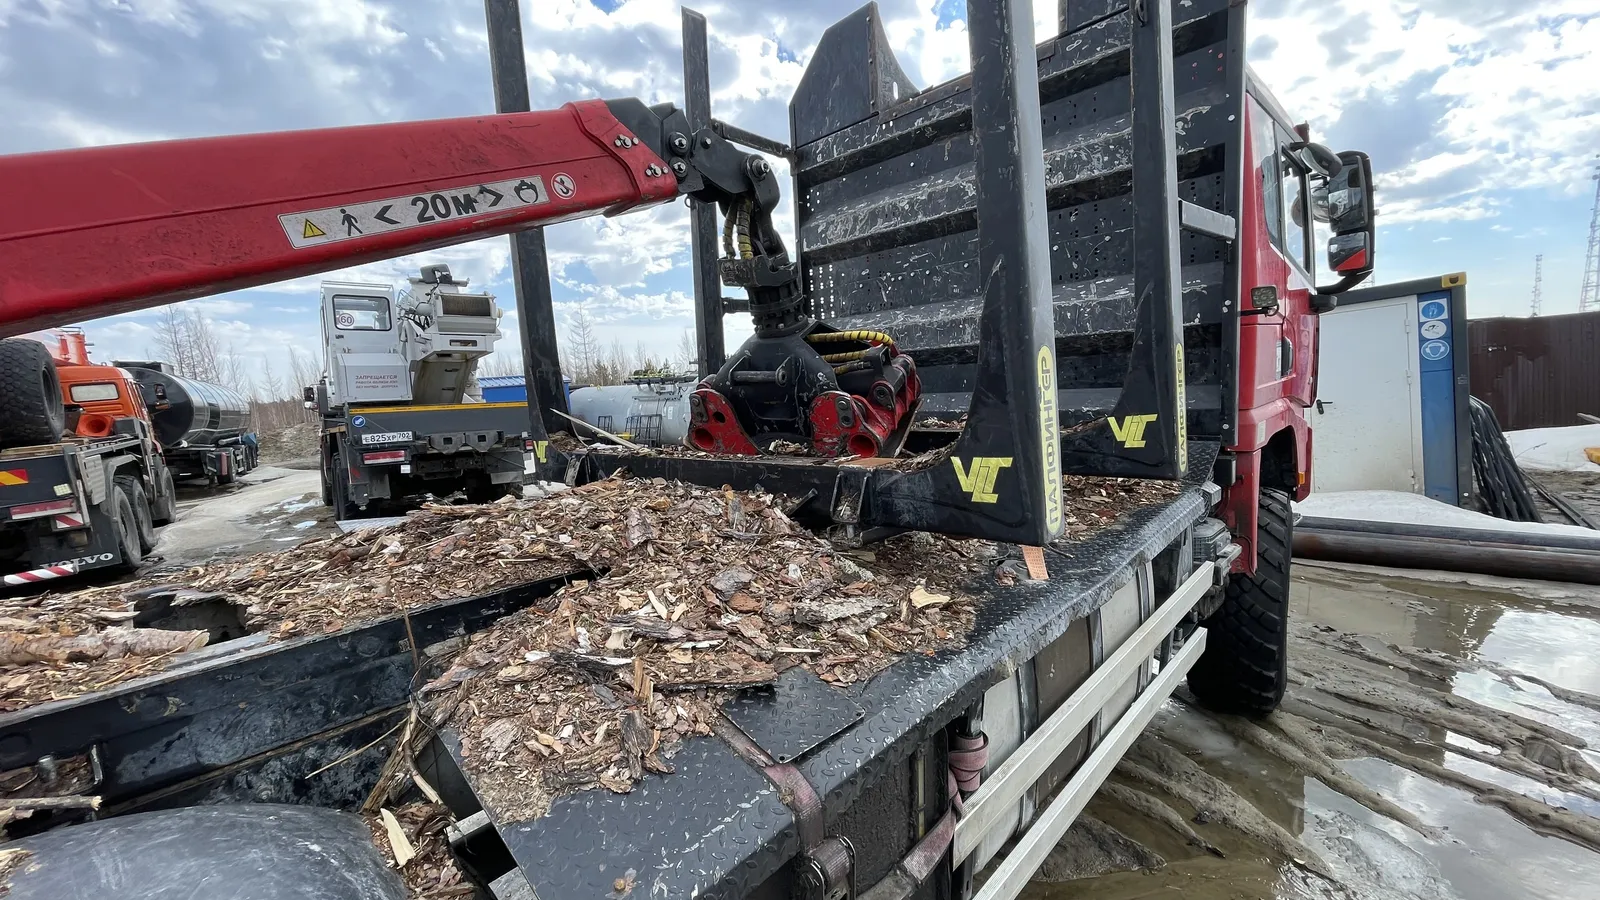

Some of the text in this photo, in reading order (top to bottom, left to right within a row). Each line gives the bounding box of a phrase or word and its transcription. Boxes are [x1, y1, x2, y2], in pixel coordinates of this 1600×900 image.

[340, 316, 352, 324] 60
[1041, 356, 1059, 524] ПАЛФИНГЕР
[1177, 350, 1186, 465] ПАЛФИНГЕР
